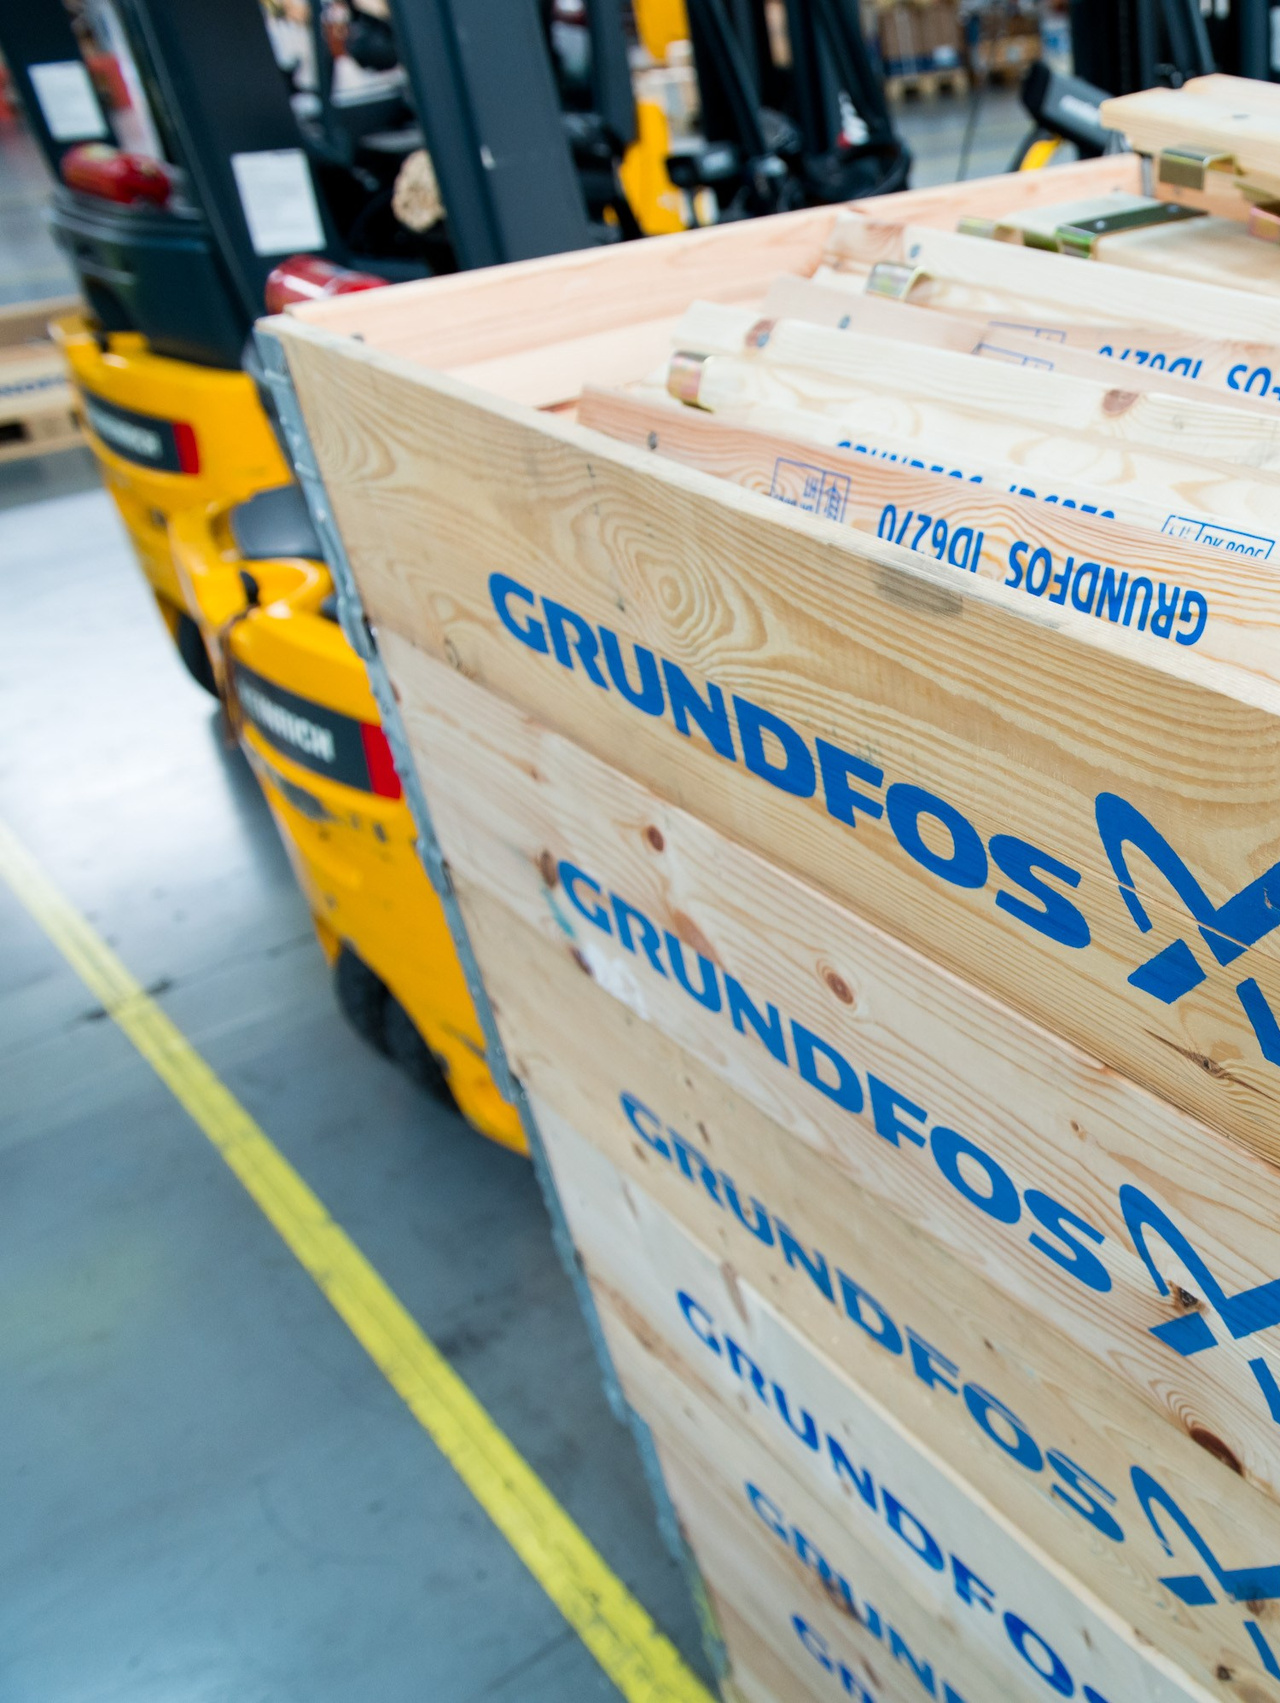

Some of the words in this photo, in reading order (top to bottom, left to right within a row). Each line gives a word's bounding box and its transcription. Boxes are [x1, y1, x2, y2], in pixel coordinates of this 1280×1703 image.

[877, 504, 984, 573] ID6270
[1004, 541, 1208, 646] GRUNDFOS
[488, 573, 1091, 949] GRUNDFOS
[558, 861, 1112, 1293] GRUNDFOS
[620, 1091, 1125, 1542] GRUNDFOS
